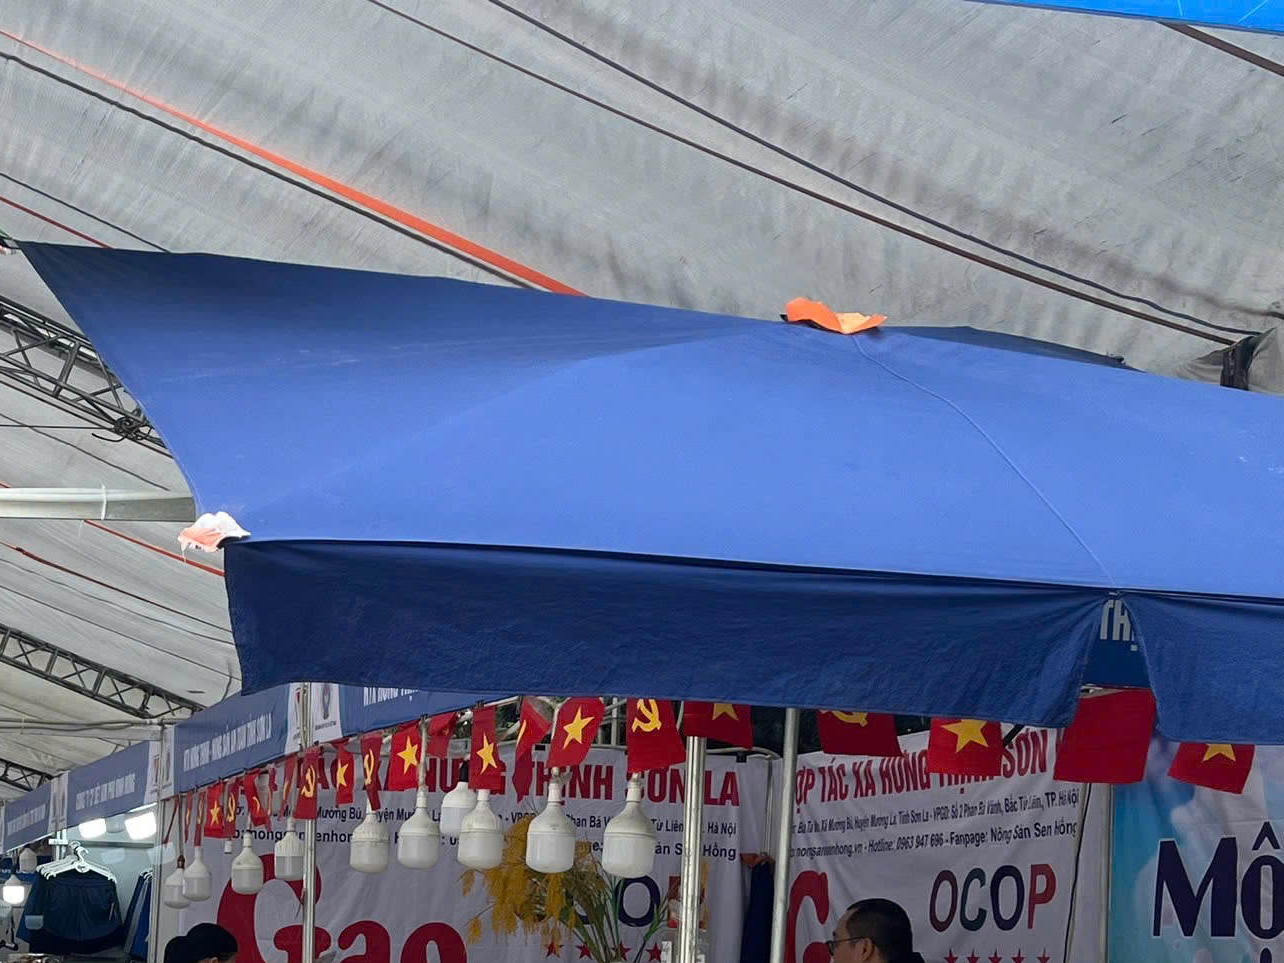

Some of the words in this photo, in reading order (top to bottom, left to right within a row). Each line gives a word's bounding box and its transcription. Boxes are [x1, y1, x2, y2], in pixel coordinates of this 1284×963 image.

[704, 770, 740, 807] LA
[818, 757, 849, 803] TÁC
[589, 815, 601, 828] Bá
[721, 822, 736, 838] Nội
[915, 834, 929, 849] 947
[950, 831, 988, 849] Fanpage:
[990, 825, 1012, 845] Nông
[1034, 822, 1052, 838] Sen
[703, 842, 736, 861] Hồng
[929, 863, 1057, 932] OCOP
